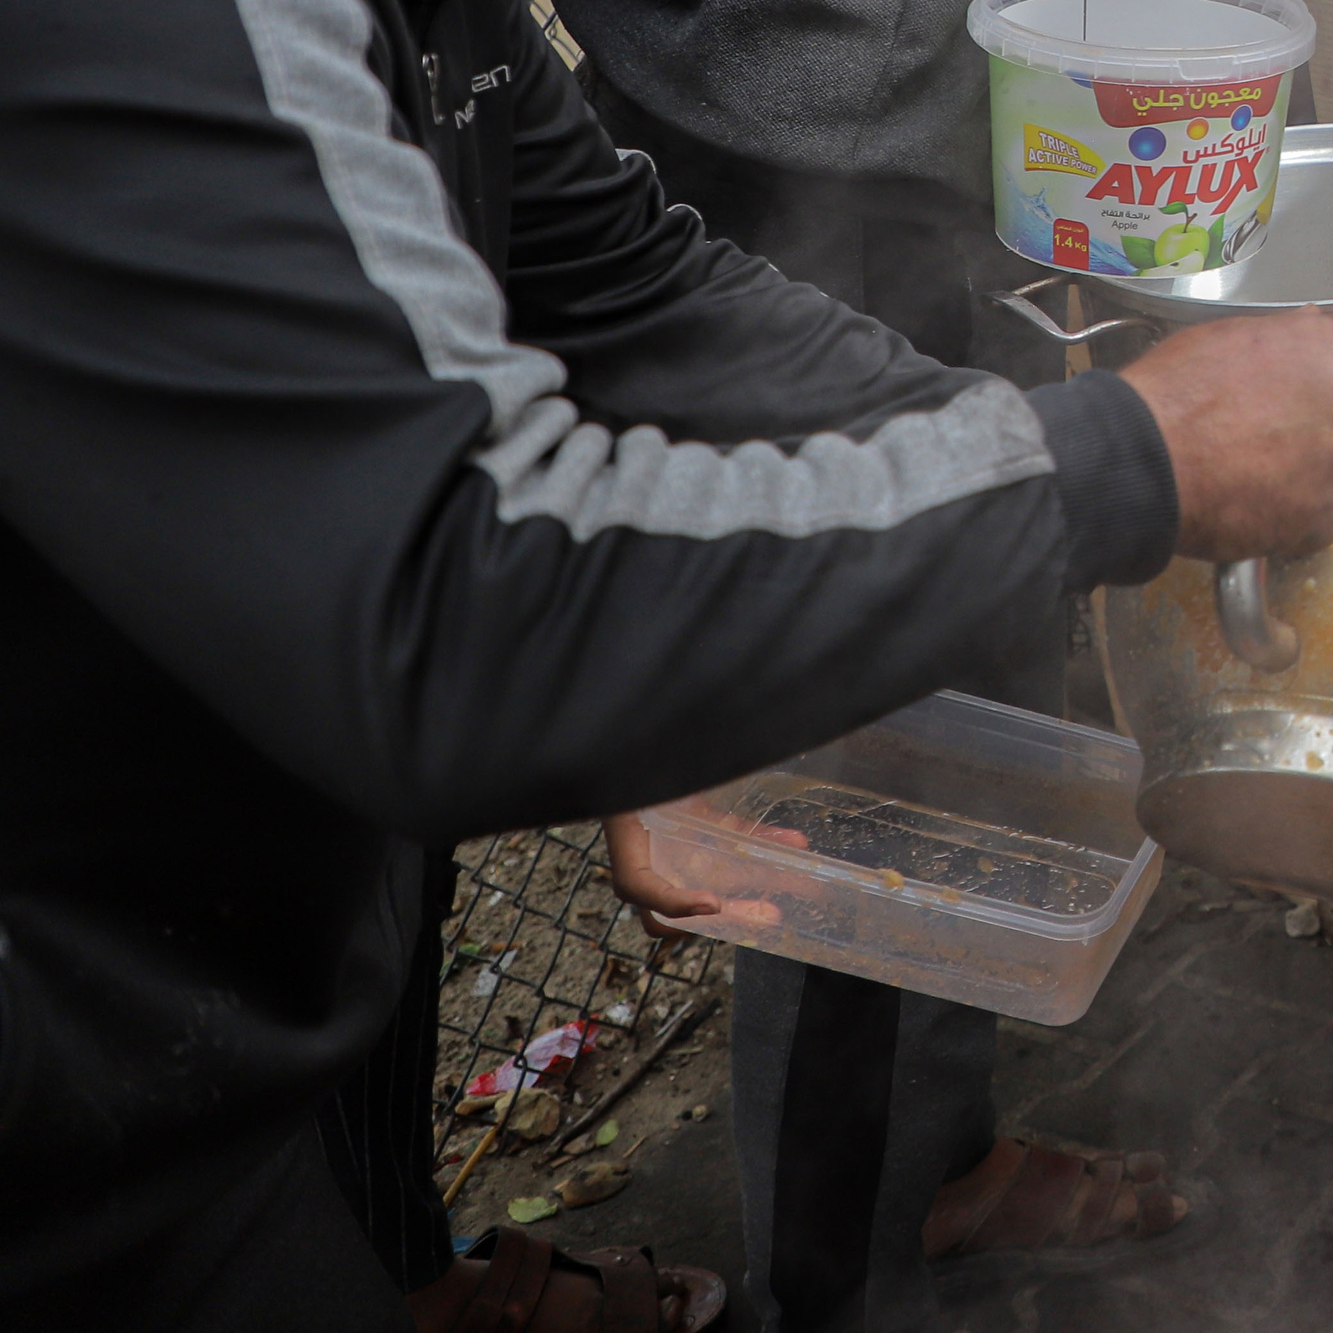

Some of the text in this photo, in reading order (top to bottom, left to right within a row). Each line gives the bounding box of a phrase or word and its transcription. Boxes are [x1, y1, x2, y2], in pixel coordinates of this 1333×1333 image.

[1132, 87, 1262, 116] معجون جلي
[1038, 131, 1080, 158] TRIPLE
[1028, 148, 1098, 175] ACTIVE POWER
[1085, 148, 1267, 216] AYLUX
[1112, 220, 1138, 230] Apple
[1054, 233, 1073, 248] 1.4
